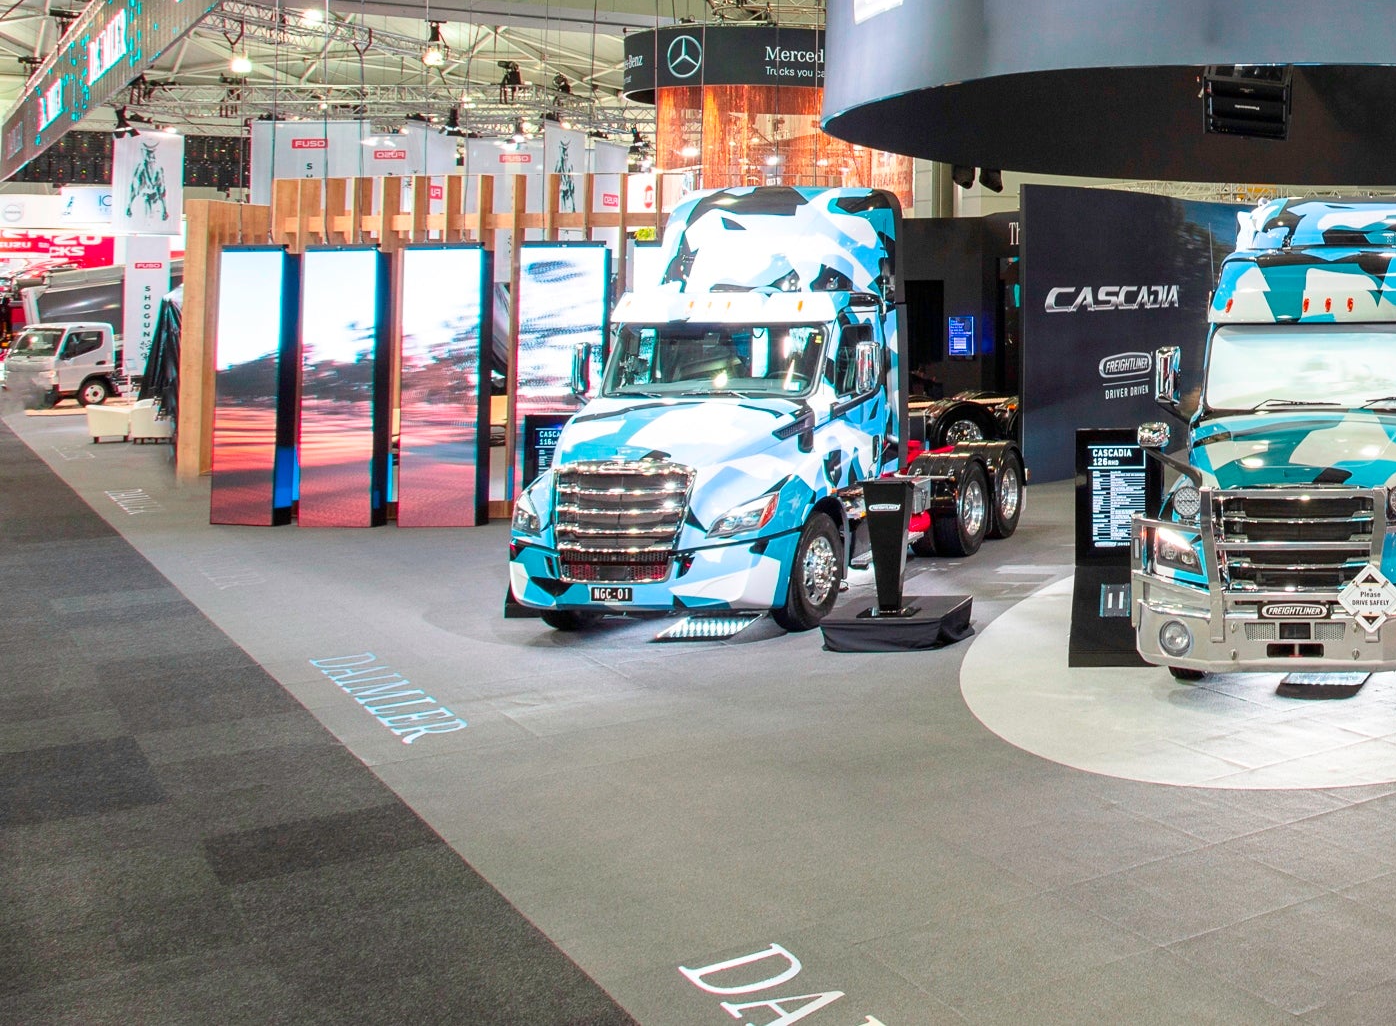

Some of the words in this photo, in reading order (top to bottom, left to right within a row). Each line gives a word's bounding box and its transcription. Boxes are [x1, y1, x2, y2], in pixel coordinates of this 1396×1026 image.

[765, 66, 795, 77] Trucks
[797, 68, 814, 78] you
[294, 140, 326, 148] FUSO
[1045, 285, 1180, 313] CASCADIA
[1105, 357, 1148, 373] FREIGHTLINER
[1105, 387, 1128, 400] DRIVER
[1130, 384, 1149, 397] DRIVEN
[1092, 448, 1132, 457] CASCADIA
[1268, 606, 1321, 616] FREIGHTLINER
[309, 651, 469, 744] DAIMLER
